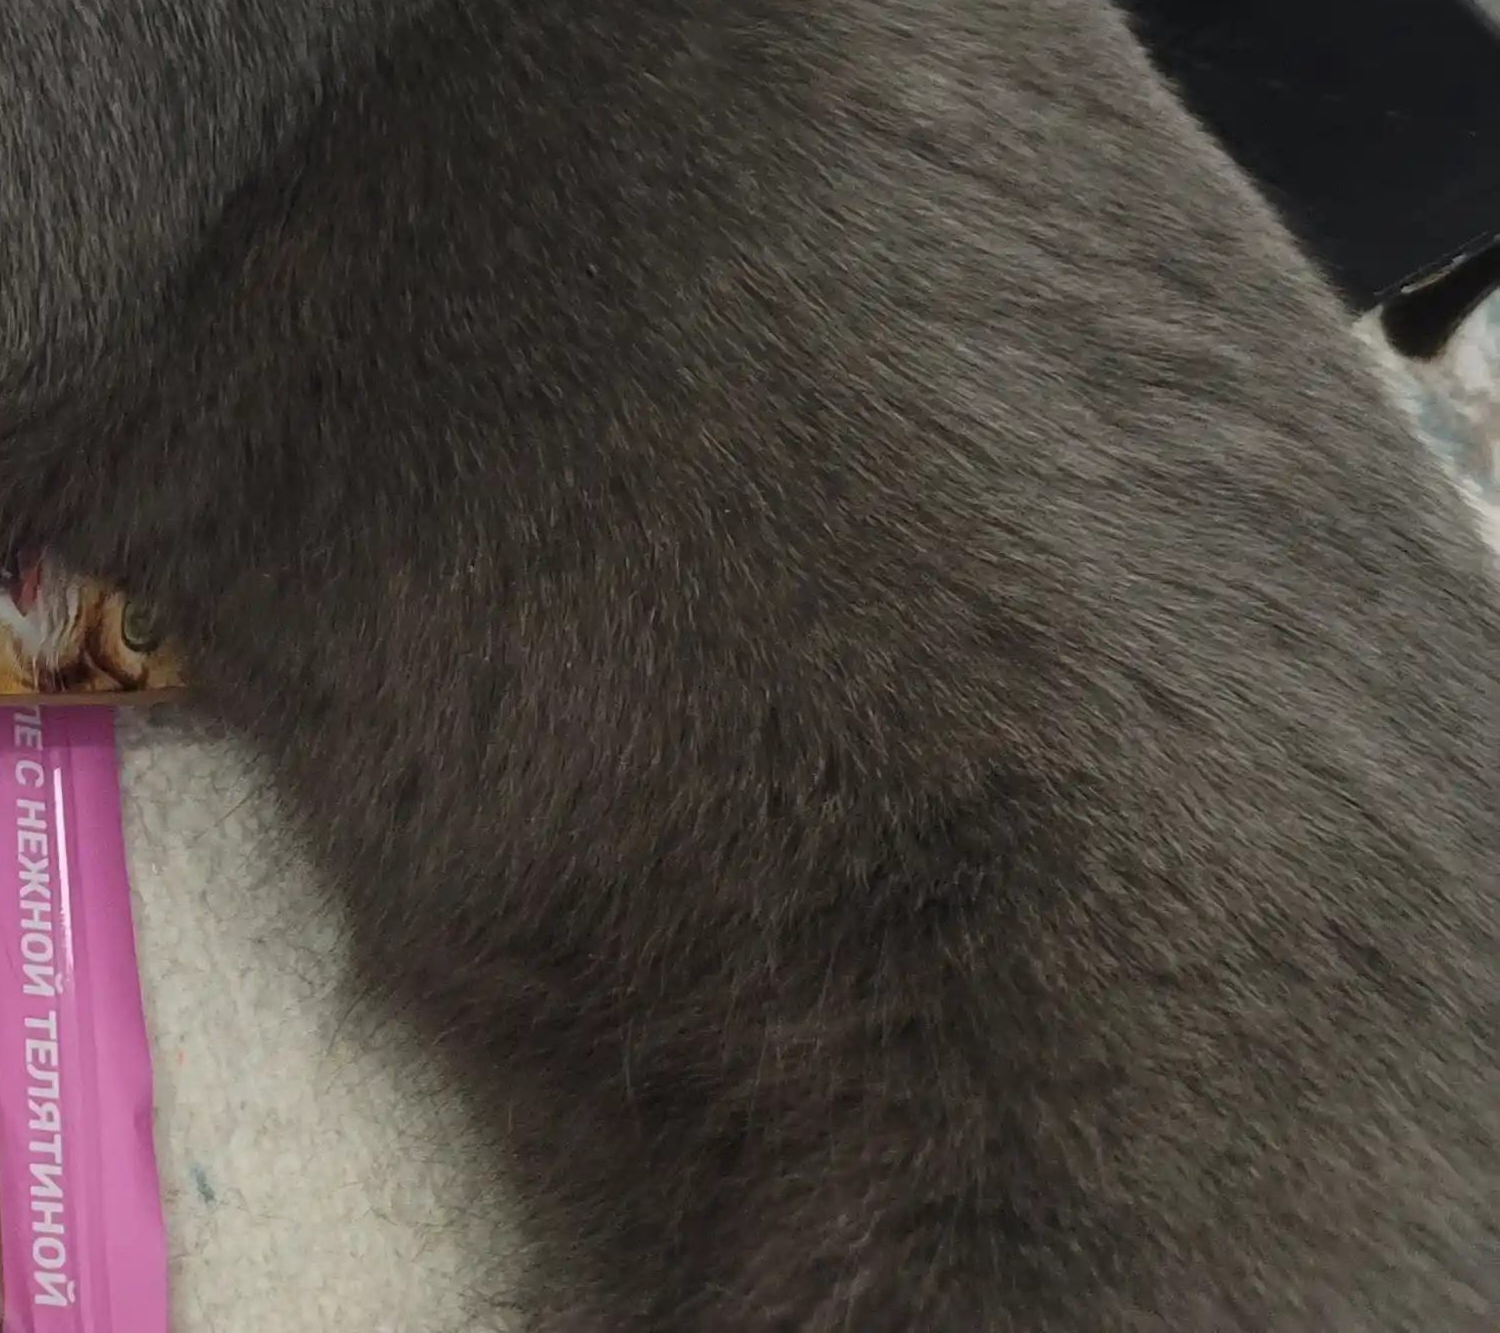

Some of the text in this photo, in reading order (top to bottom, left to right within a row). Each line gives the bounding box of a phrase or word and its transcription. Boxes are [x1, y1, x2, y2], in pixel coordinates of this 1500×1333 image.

[14, 759, 45, 789] С
[15, 798, 64, 998] НЕЖНОЙ
[23, 1009, 76, 1308] ТЕЛЯТИНОЙ
